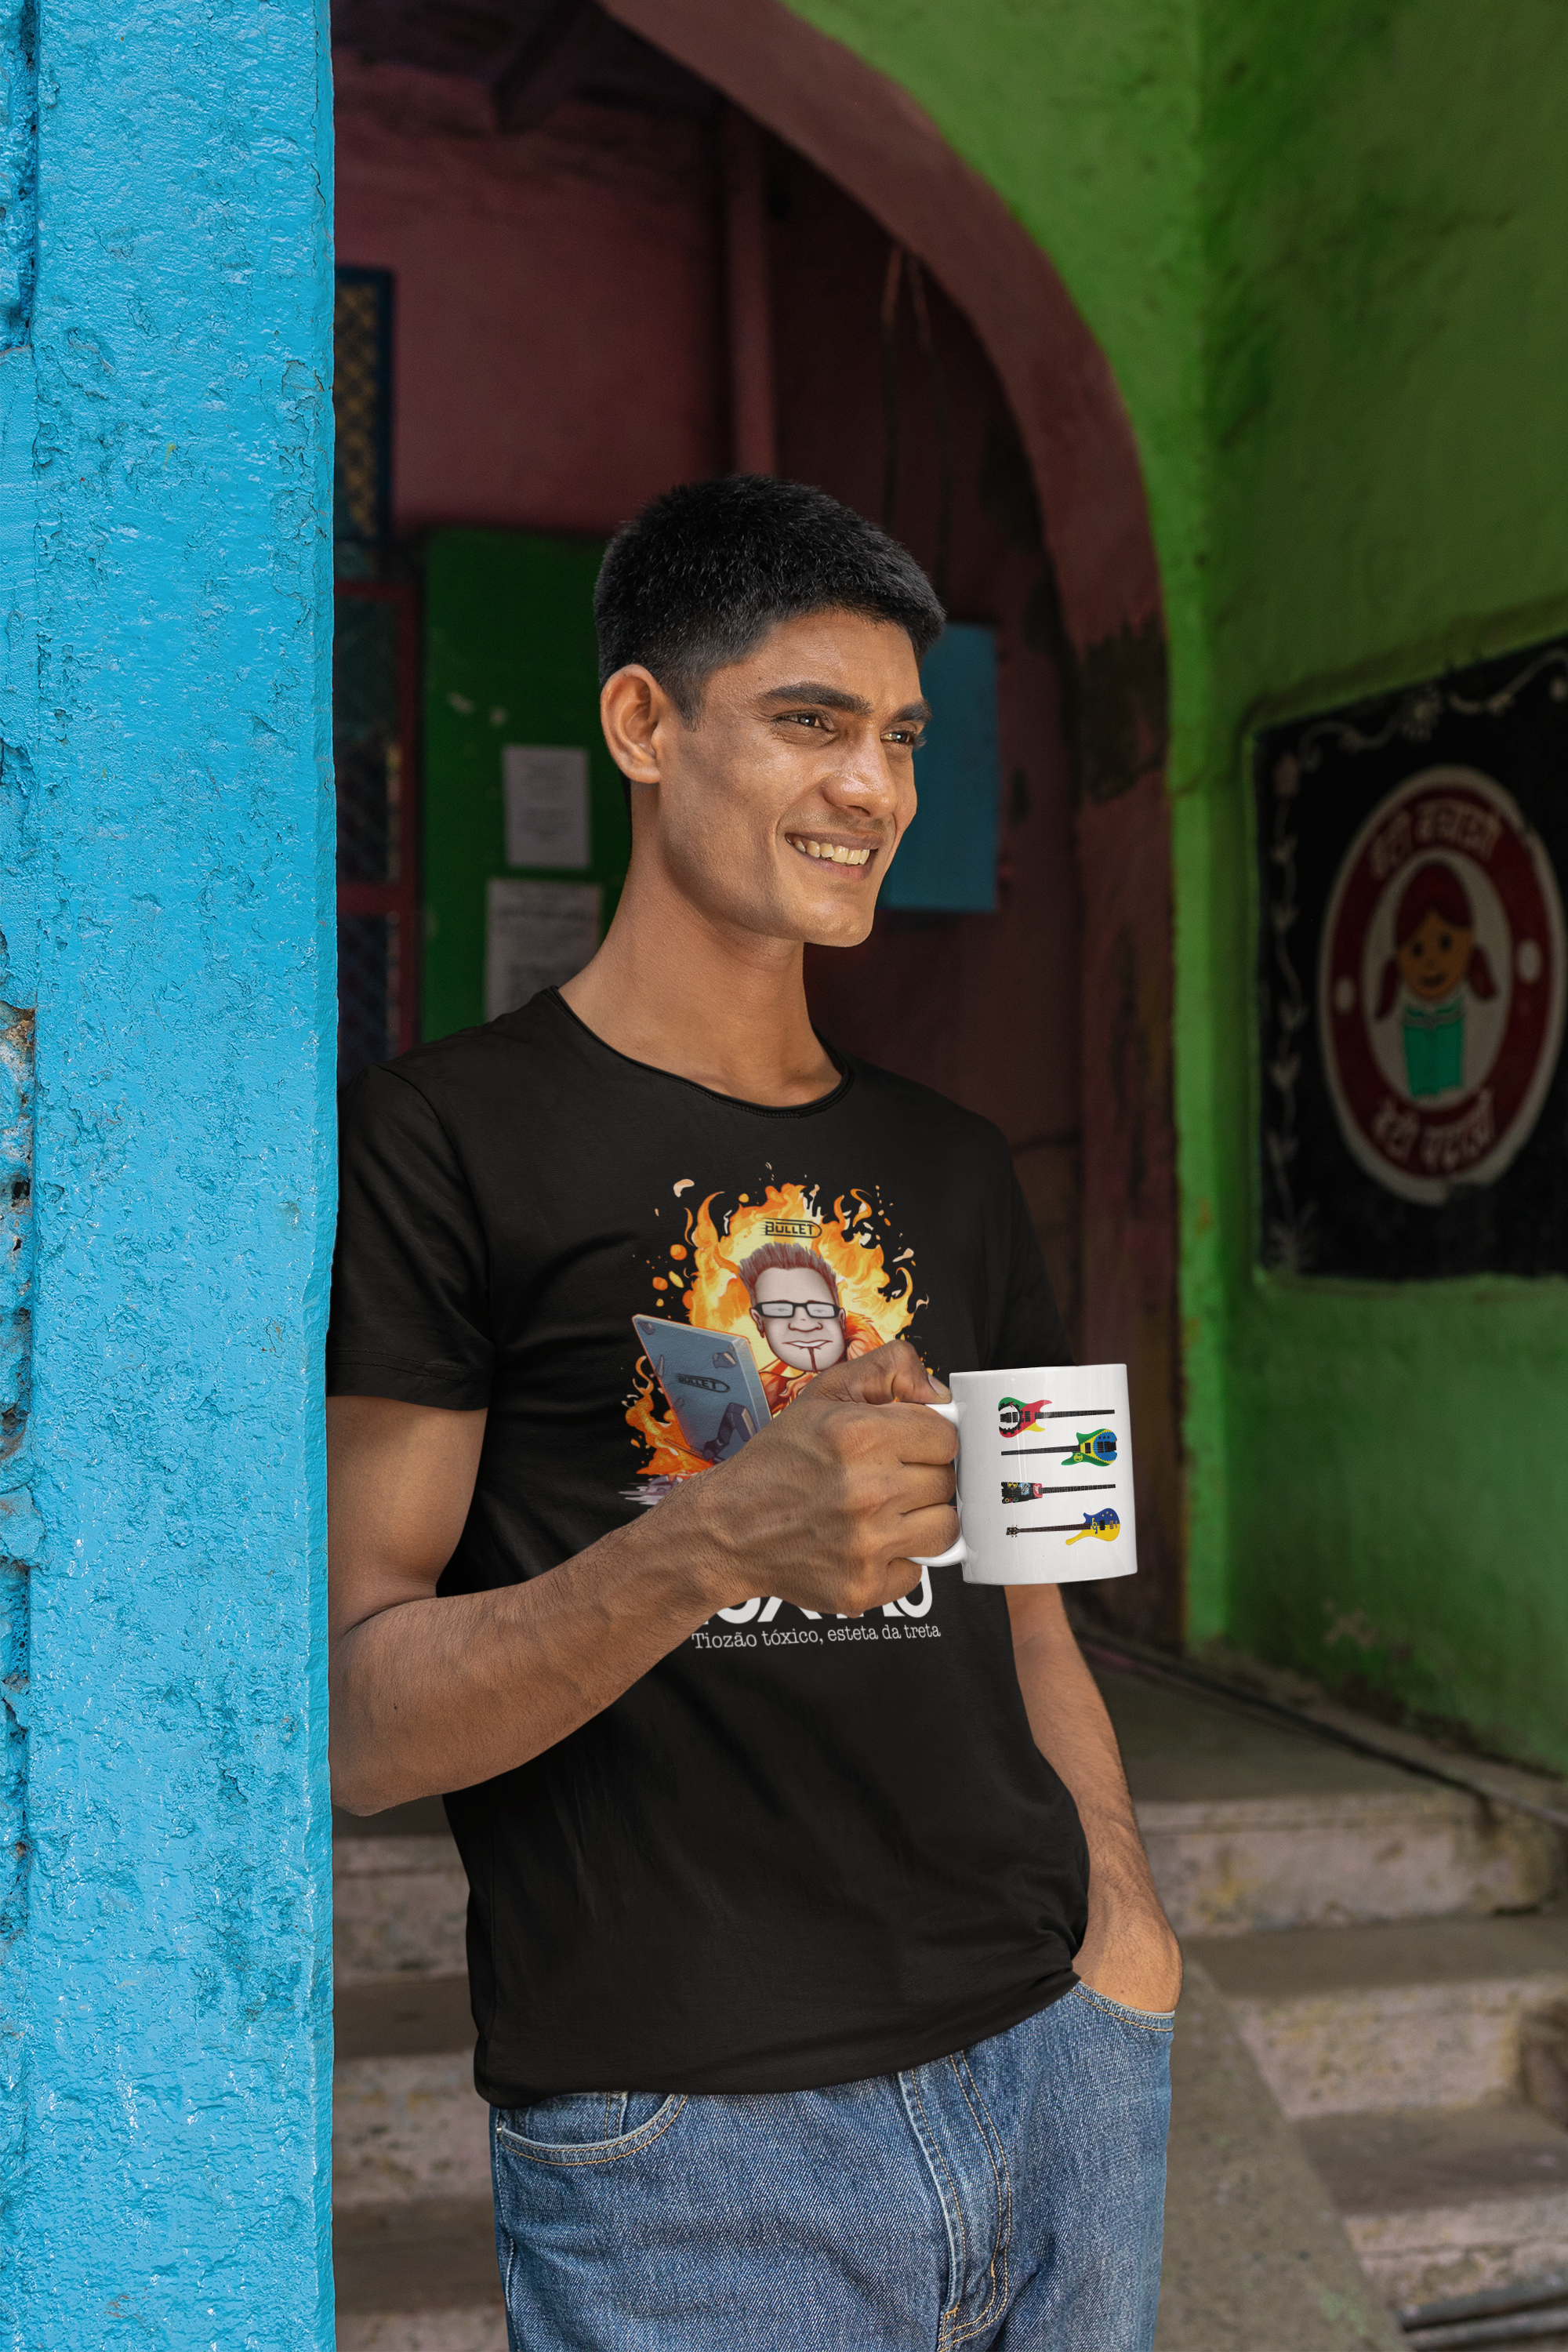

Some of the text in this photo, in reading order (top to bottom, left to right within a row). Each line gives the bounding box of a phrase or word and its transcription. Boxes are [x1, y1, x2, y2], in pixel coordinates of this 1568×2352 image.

[764, 1221, 815, 1236] BULLET
[677, 1374, 720, 1390] BULLET
[691, 1623, 942, 1649] Tiozão tóxico, esteta da treta
